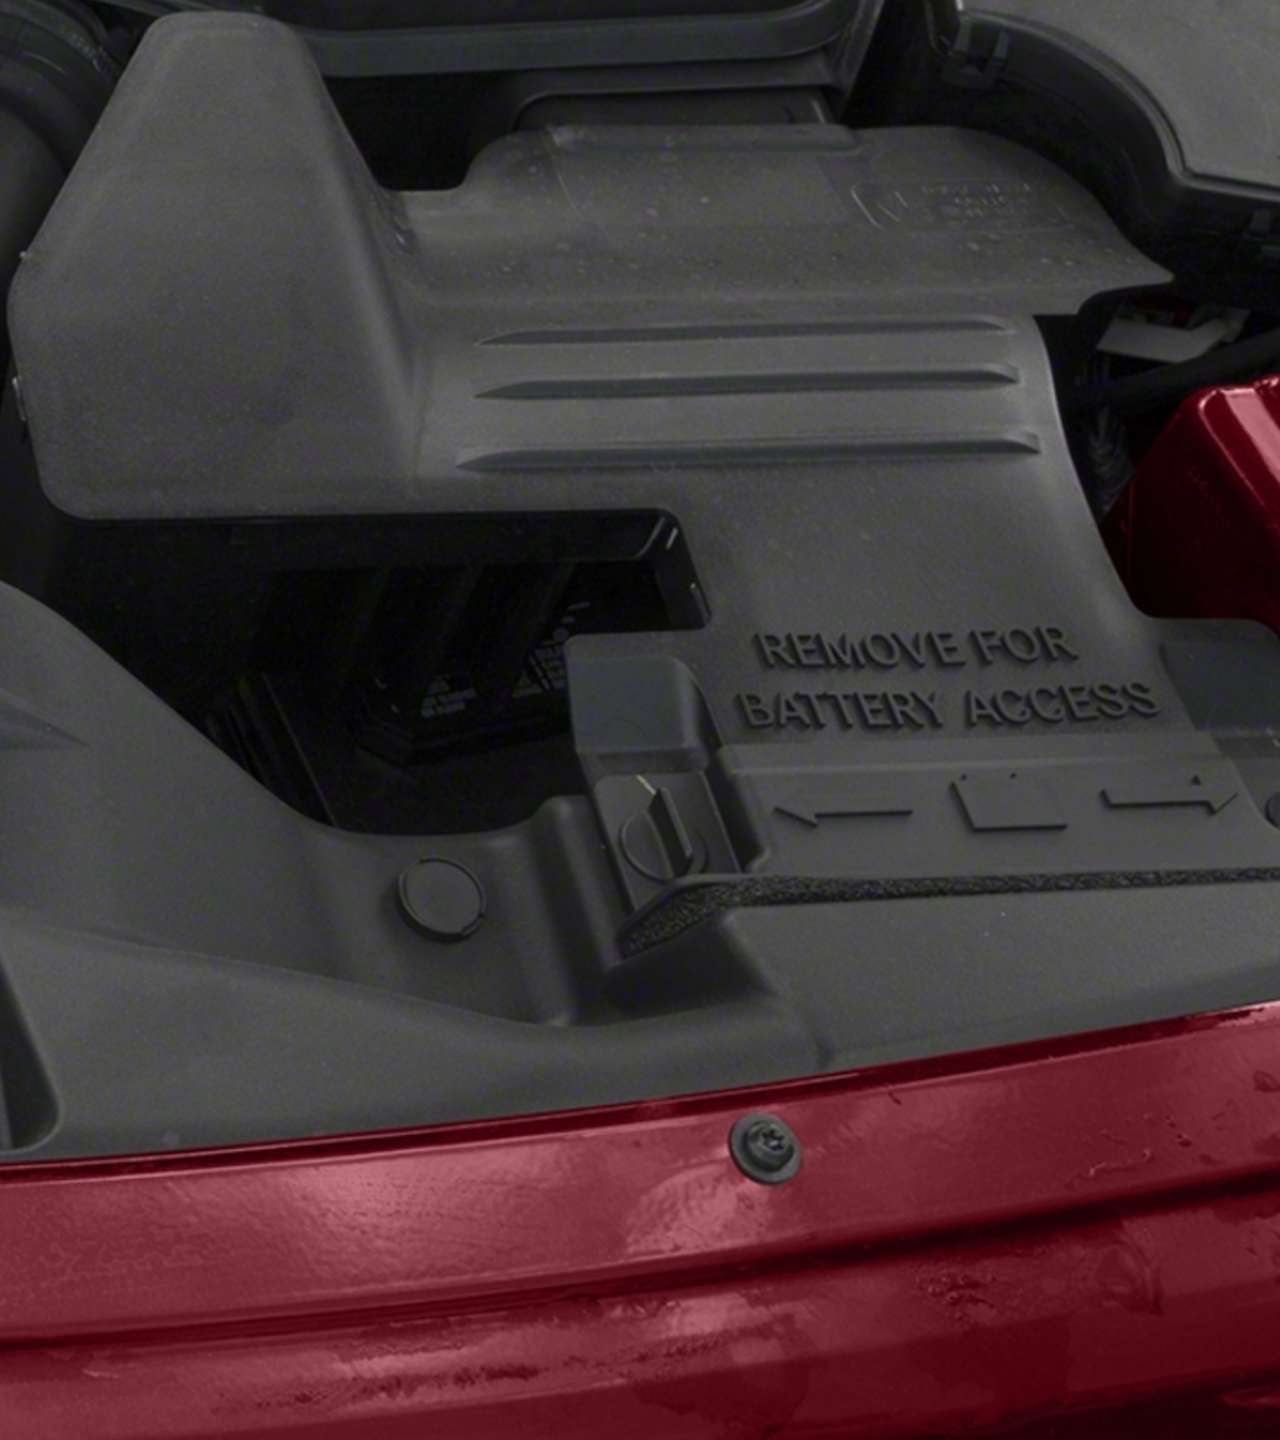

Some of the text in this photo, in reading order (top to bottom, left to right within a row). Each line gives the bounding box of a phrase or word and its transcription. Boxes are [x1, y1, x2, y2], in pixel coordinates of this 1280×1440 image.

[752, 626, 1079, 670] REMOVE FOR
[738, 681, 1162, 730] BATTERY ACCESS
